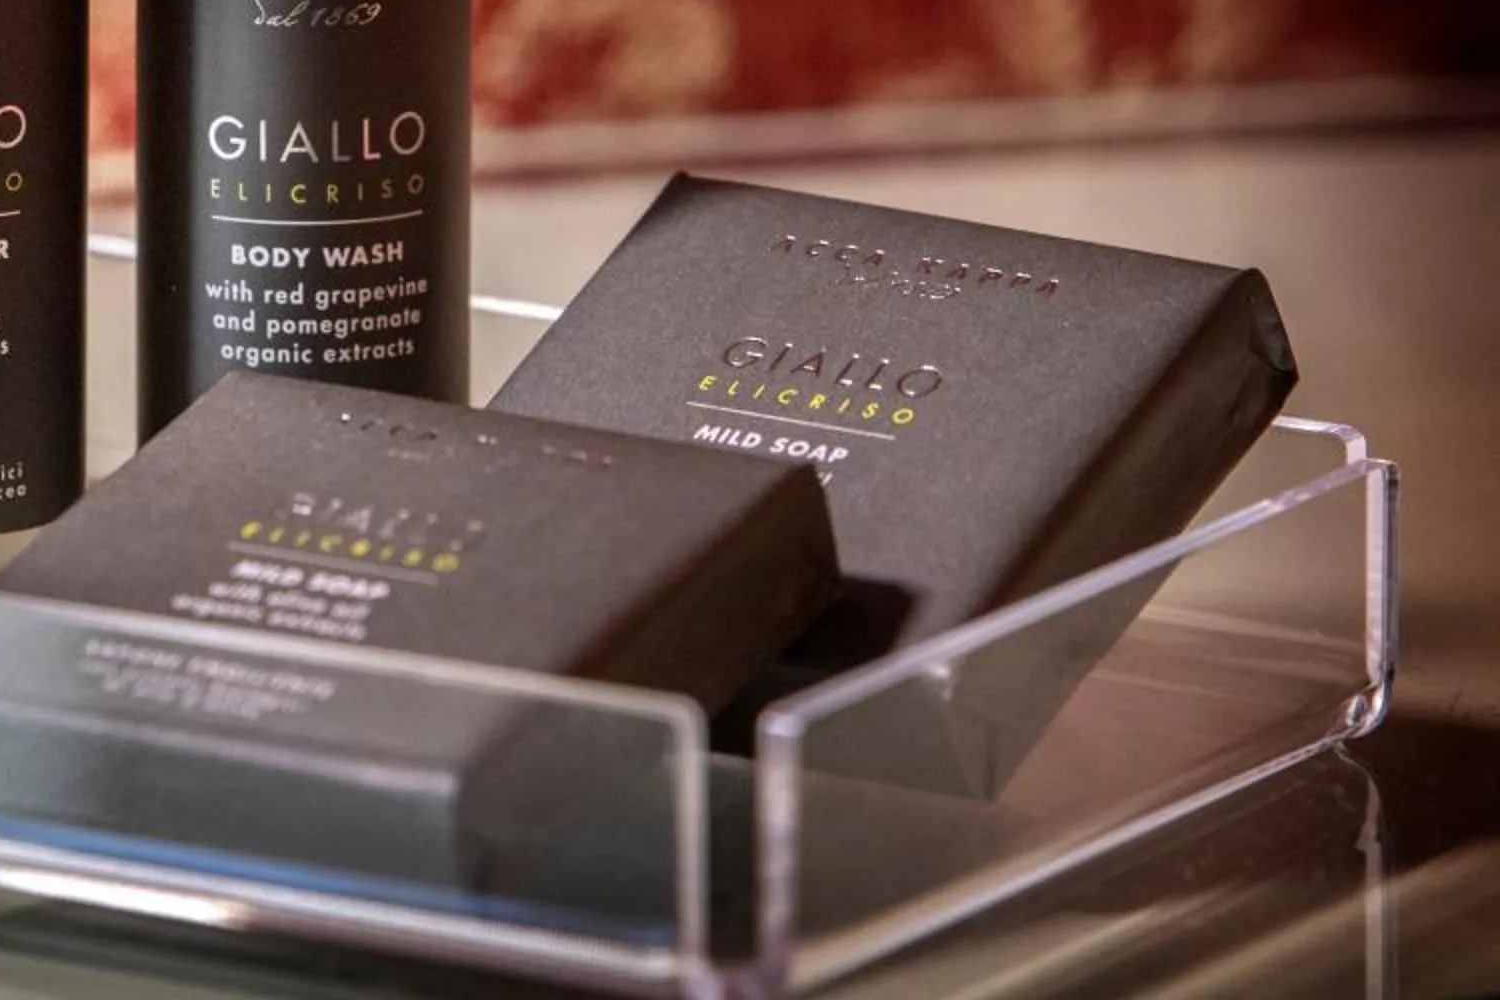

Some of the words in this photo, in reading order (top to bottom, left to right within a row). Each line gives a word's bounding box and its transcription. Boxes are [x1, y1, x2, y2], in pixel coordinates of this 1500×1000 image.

[208, 111, 426, 163] GIALLO
[210, 174, 425, 203] ELICRISO
[231, 244, 311, 268] BODY
[323, 241, 405, 267] WASH
[205, 281, 253, 303] with
[263, 283, 304, 305] red
[315, 278, 428, 311] grapevine
[213, 311, 255, 332] and
[266, 309, 422, 338] pomegranate
[220, 344, 313, 368] organic
[323, 337, 415, 364] extracts
[721, 335, 943, 398] GIALLO
[699, 375, 915, 425] ELICRISO
[693, 424, 762, 449] MILD
[770, 437, 849, 464] SOAP
